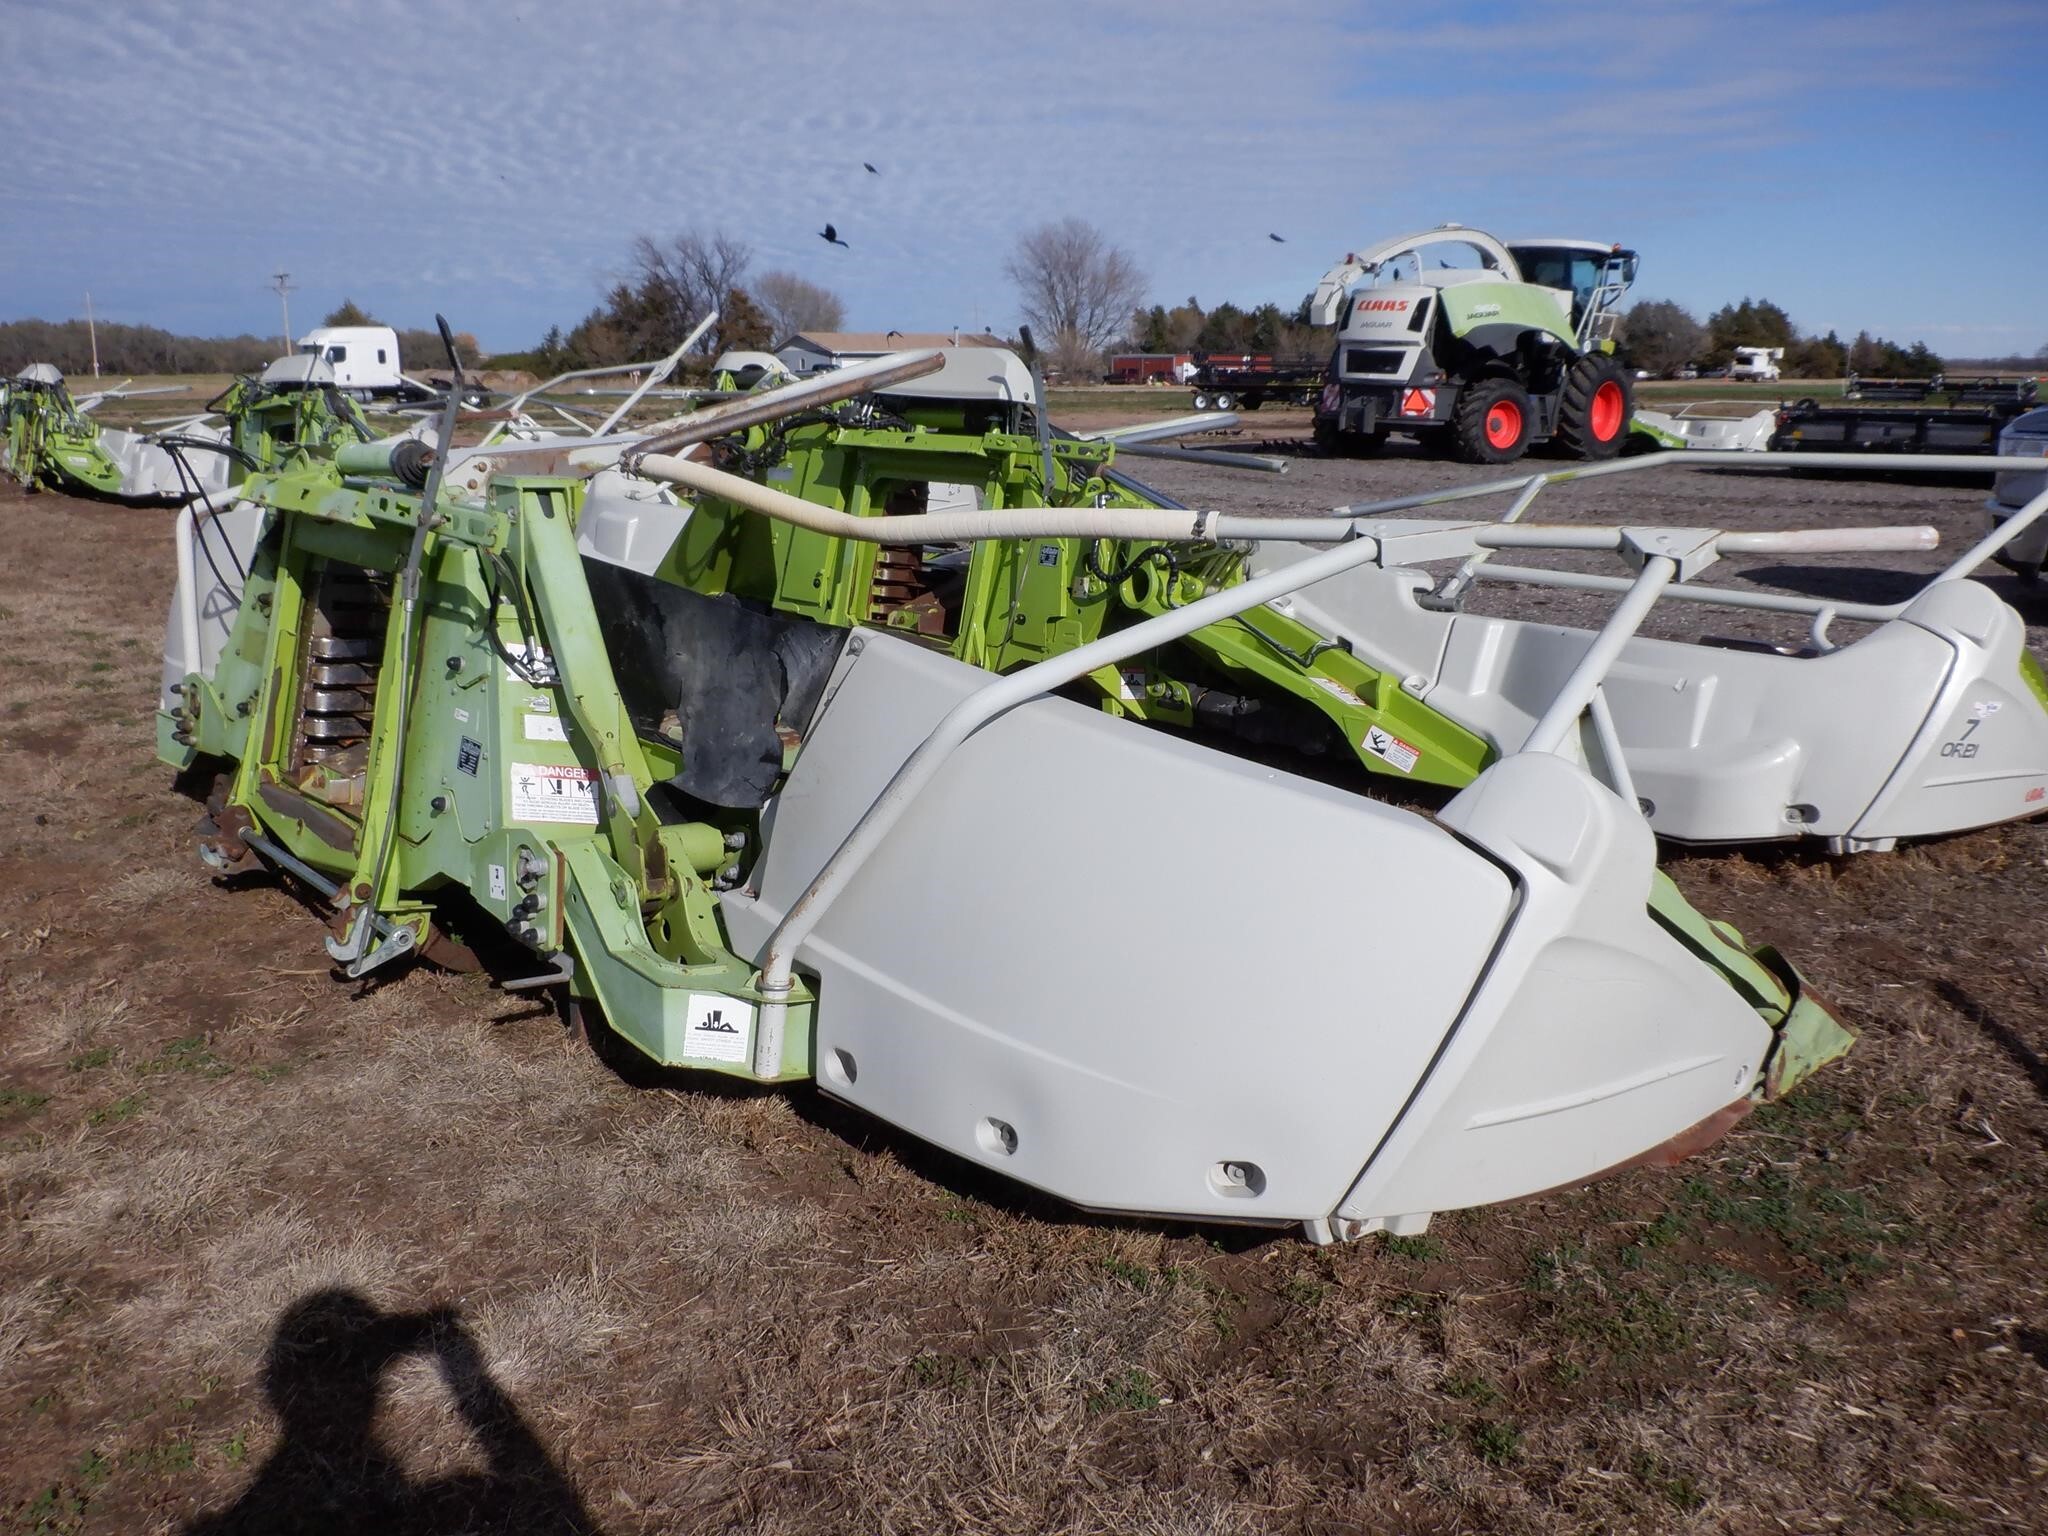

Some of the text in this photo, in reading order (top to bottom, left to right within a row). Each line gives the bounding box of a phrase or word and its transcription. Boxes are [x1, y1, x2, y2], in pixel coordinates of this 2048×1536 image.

[1357, 300, 1409, 312] CLAAS
[1959, 719, 1981, 741] 7
[539, 765, 589, 779] DANGER
